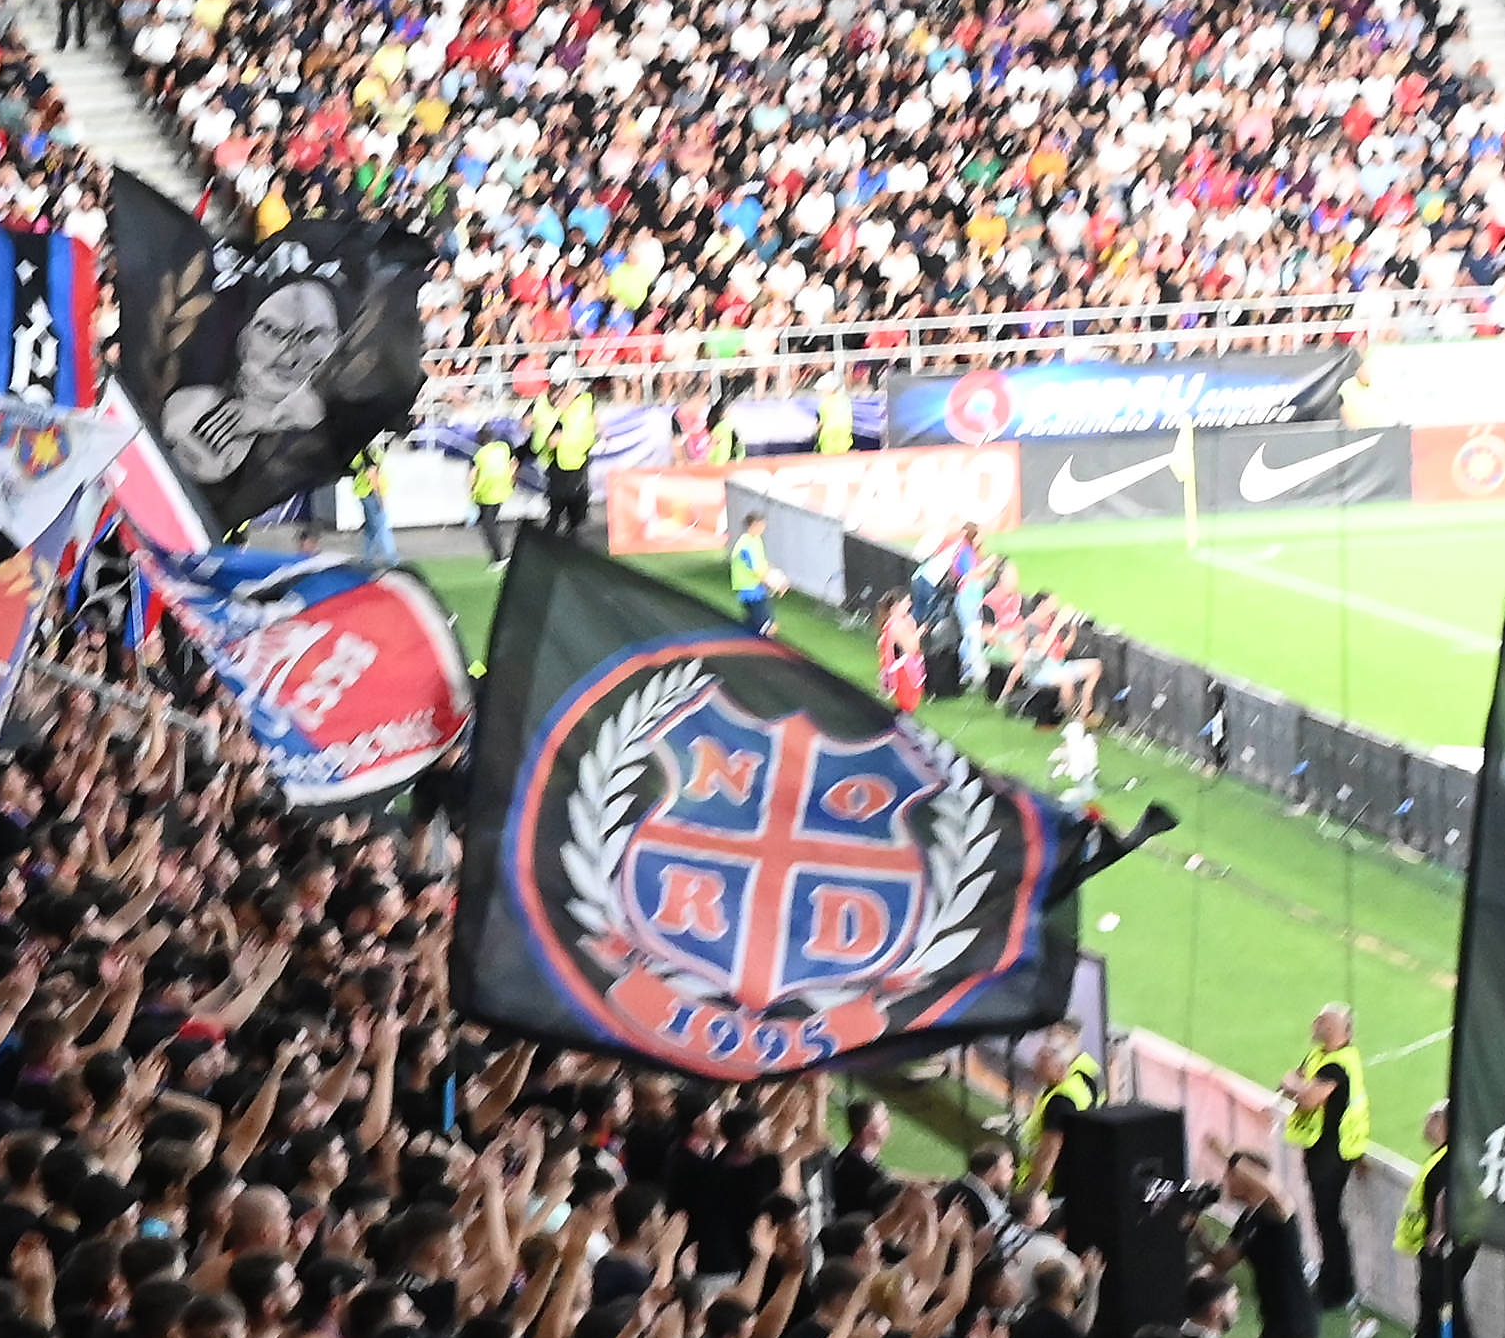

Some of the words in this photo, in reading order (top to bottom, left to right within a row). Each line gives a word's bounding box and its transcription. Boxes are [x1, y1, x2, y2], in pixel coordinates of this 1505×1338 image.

[715, 450, 1016, 533] ETANO
[683, 735, 765, 806] N
[820, 772, 898, 823] O
[653, 864, 729, 942] R
[800, 883, 892, 964] D
[662, 995, 845, 1065] 1995
